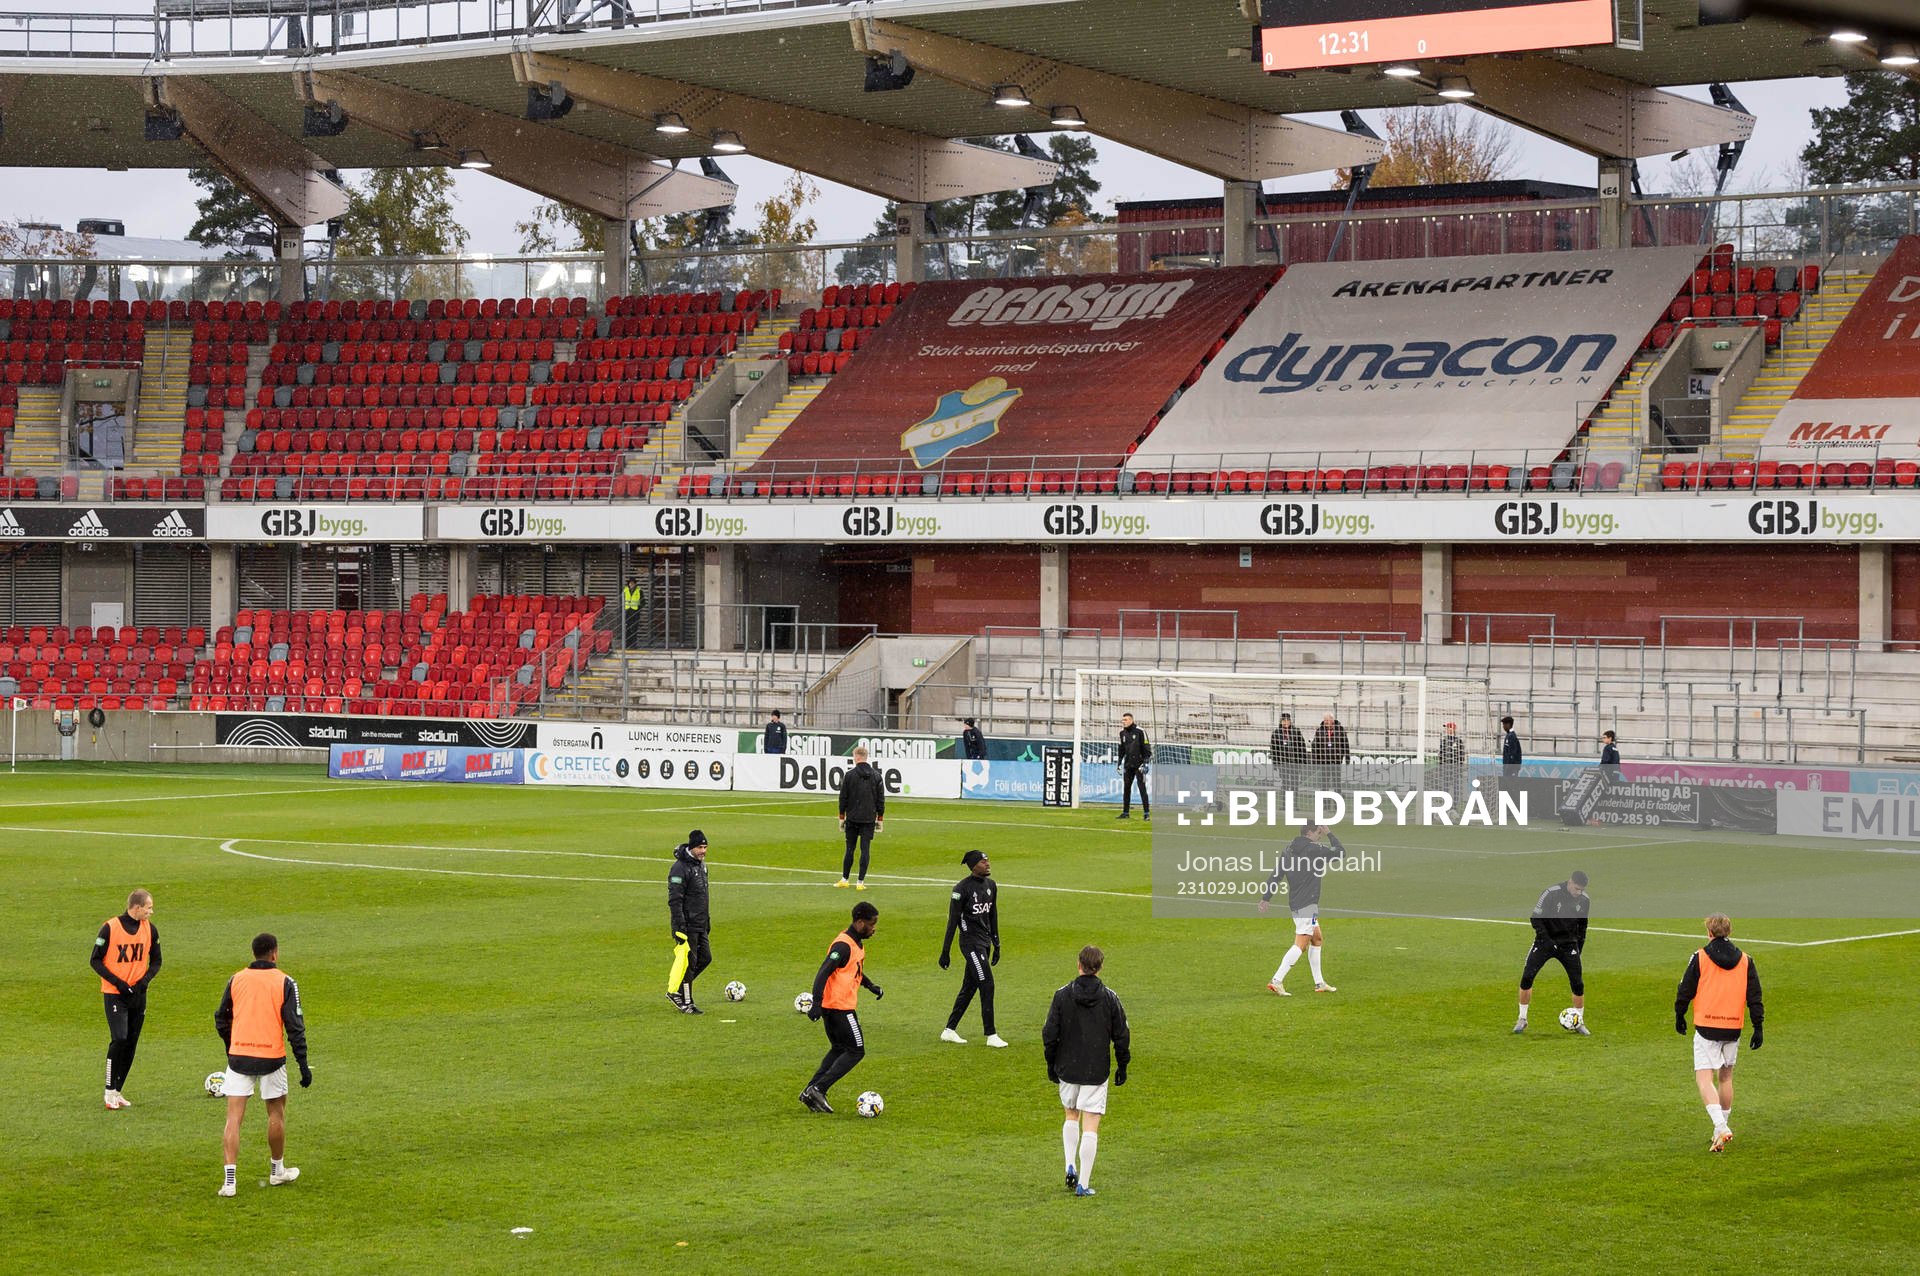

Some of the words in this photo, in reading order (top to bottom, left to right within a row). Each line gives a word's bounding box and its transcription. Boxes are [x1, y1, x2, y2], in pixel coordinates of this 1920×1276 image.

[1265, 52, 1273, 66] 0
[1318, 30, 1369, 55] 12:31
[1418, 39, 1427, 54] 0
[1333, 269, 1614, 298] ARENAPARTNER
[947, 278, 1194, 330] ecosign
[918, 344, 962, 357] Stolt
[964, 338, 1142, 358] samarbetspartner
[990, 360, 1037, 374] med
[1223, 332, 1617, 394] dynacon
[1316, 375, 1592, 393] CONSTRUCTION
[1690, 379, 1703, 395] E4
[1789, 422, 1892, 441] MAXI
[261, 509, 315, 537] GBJ
[319, 515, 367, 537] bygg.
[480, 508, 524, 536] GBJ
[527, 514, 566, 537] bygg.
[655, 508, 702, 536] GBJ
[705, 513, 747, 537] bygg.
[843, 507, 893, 535] GBJ
[896, 512, 941, 536] bygg.
[1043, 505, 1098, 535] GBJ
[1101, 511, 1150, 536] bygg.
[1260, 505, 1318, 535] GBJ
[1322, 510, 1374, 535] bygg.
[1495, 503, 1558, 535] GBJ
[1562, 509, 1619, 535] bygg.
[1748, 501, 1817, 535] GBJ
[1821, 507, 1883, 535] bygg.
[0, 525, 25, 537] idas
[68, 525, 109, 537] adidas
[152, 525, 193, 537] adidas
[308, 725, 348, 740] stadium
[418, 729, 459, 743] stadium
[628, 731, 659, 742] LUNCH
[666, 732, 722, 744] KONFERENS
[553, 738, 590, 748] ÖSTERGATAN
[554, 756, 611, 772] CRETEC
[779, 756, 910, 794] Deloe.
[1046, 755, 1056, 800] SELECT
[1061, 757, 1071, 802] SELECT
[994, 779, 1010, 793] Följ
[1011, 780, 1028, 792] den
[1672, 786, 1691, 799] AB
[1634, 801, 1646, 812] på
[1655, 800, 1691, 813] fastighet
[1592, 811, 1643, 824] 0470-285
[1645, 814, 1660, 826] 90
[117, 943, 144, 963] XXI
